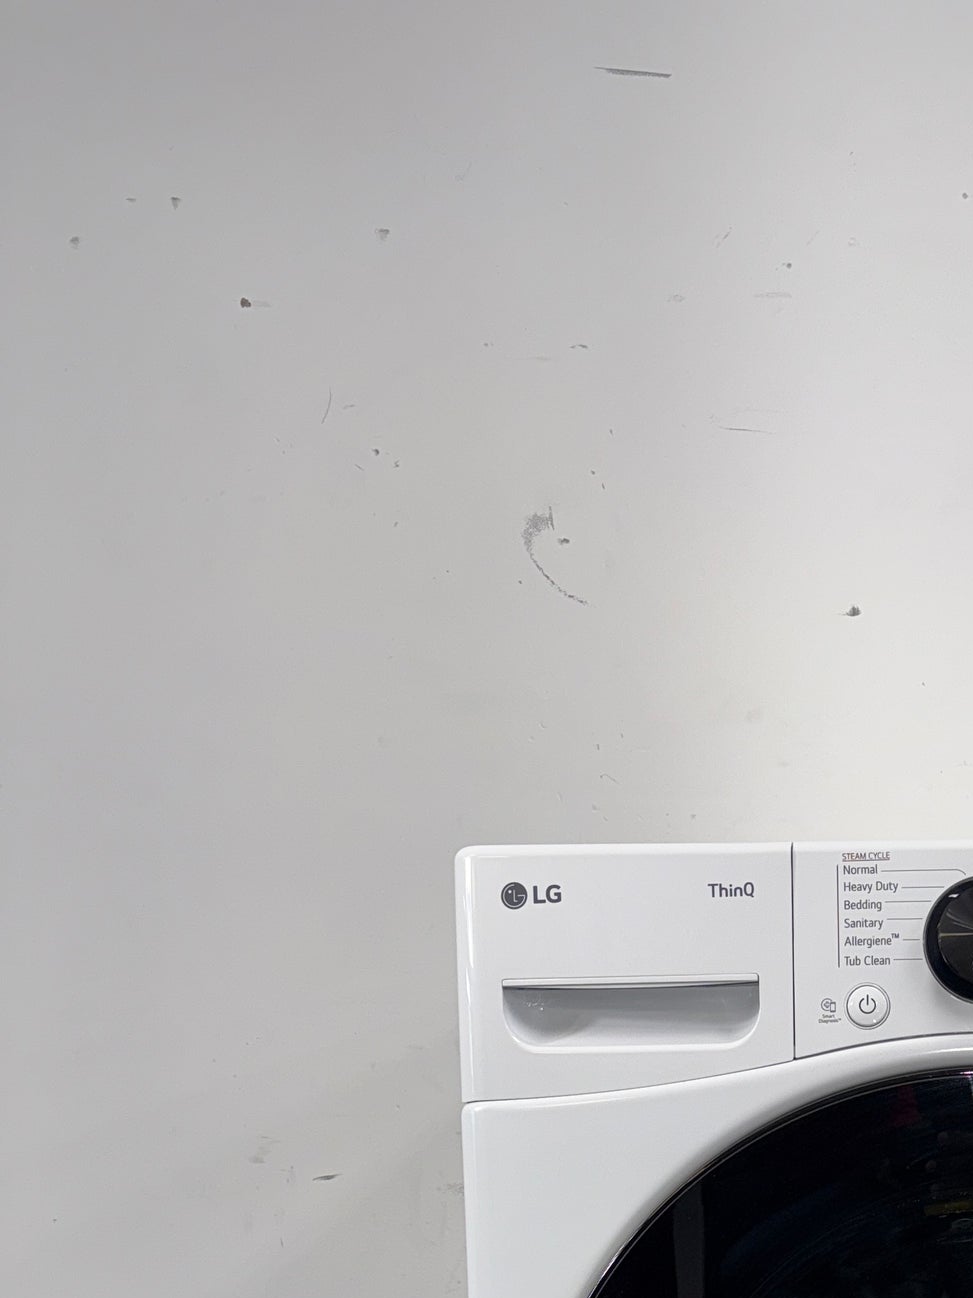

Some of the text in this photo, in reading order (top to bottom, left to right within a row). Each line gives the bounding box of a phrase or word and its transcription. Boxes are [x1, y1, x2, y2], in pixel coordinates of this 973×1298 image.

[842, 851, 890, 860] STEAM CYCLE
[843, 864, 878, 875] Normal
[708, 882, 755, 898] ThinQ
[843, 880, 899, 893] Heavy Duty
[533, 885, 562, 904] LG
[843, 899, 882, 912] Bedding
[844, 918, 884, 930] Sanitary
[844, 955, 891, 966] Tub Clean
